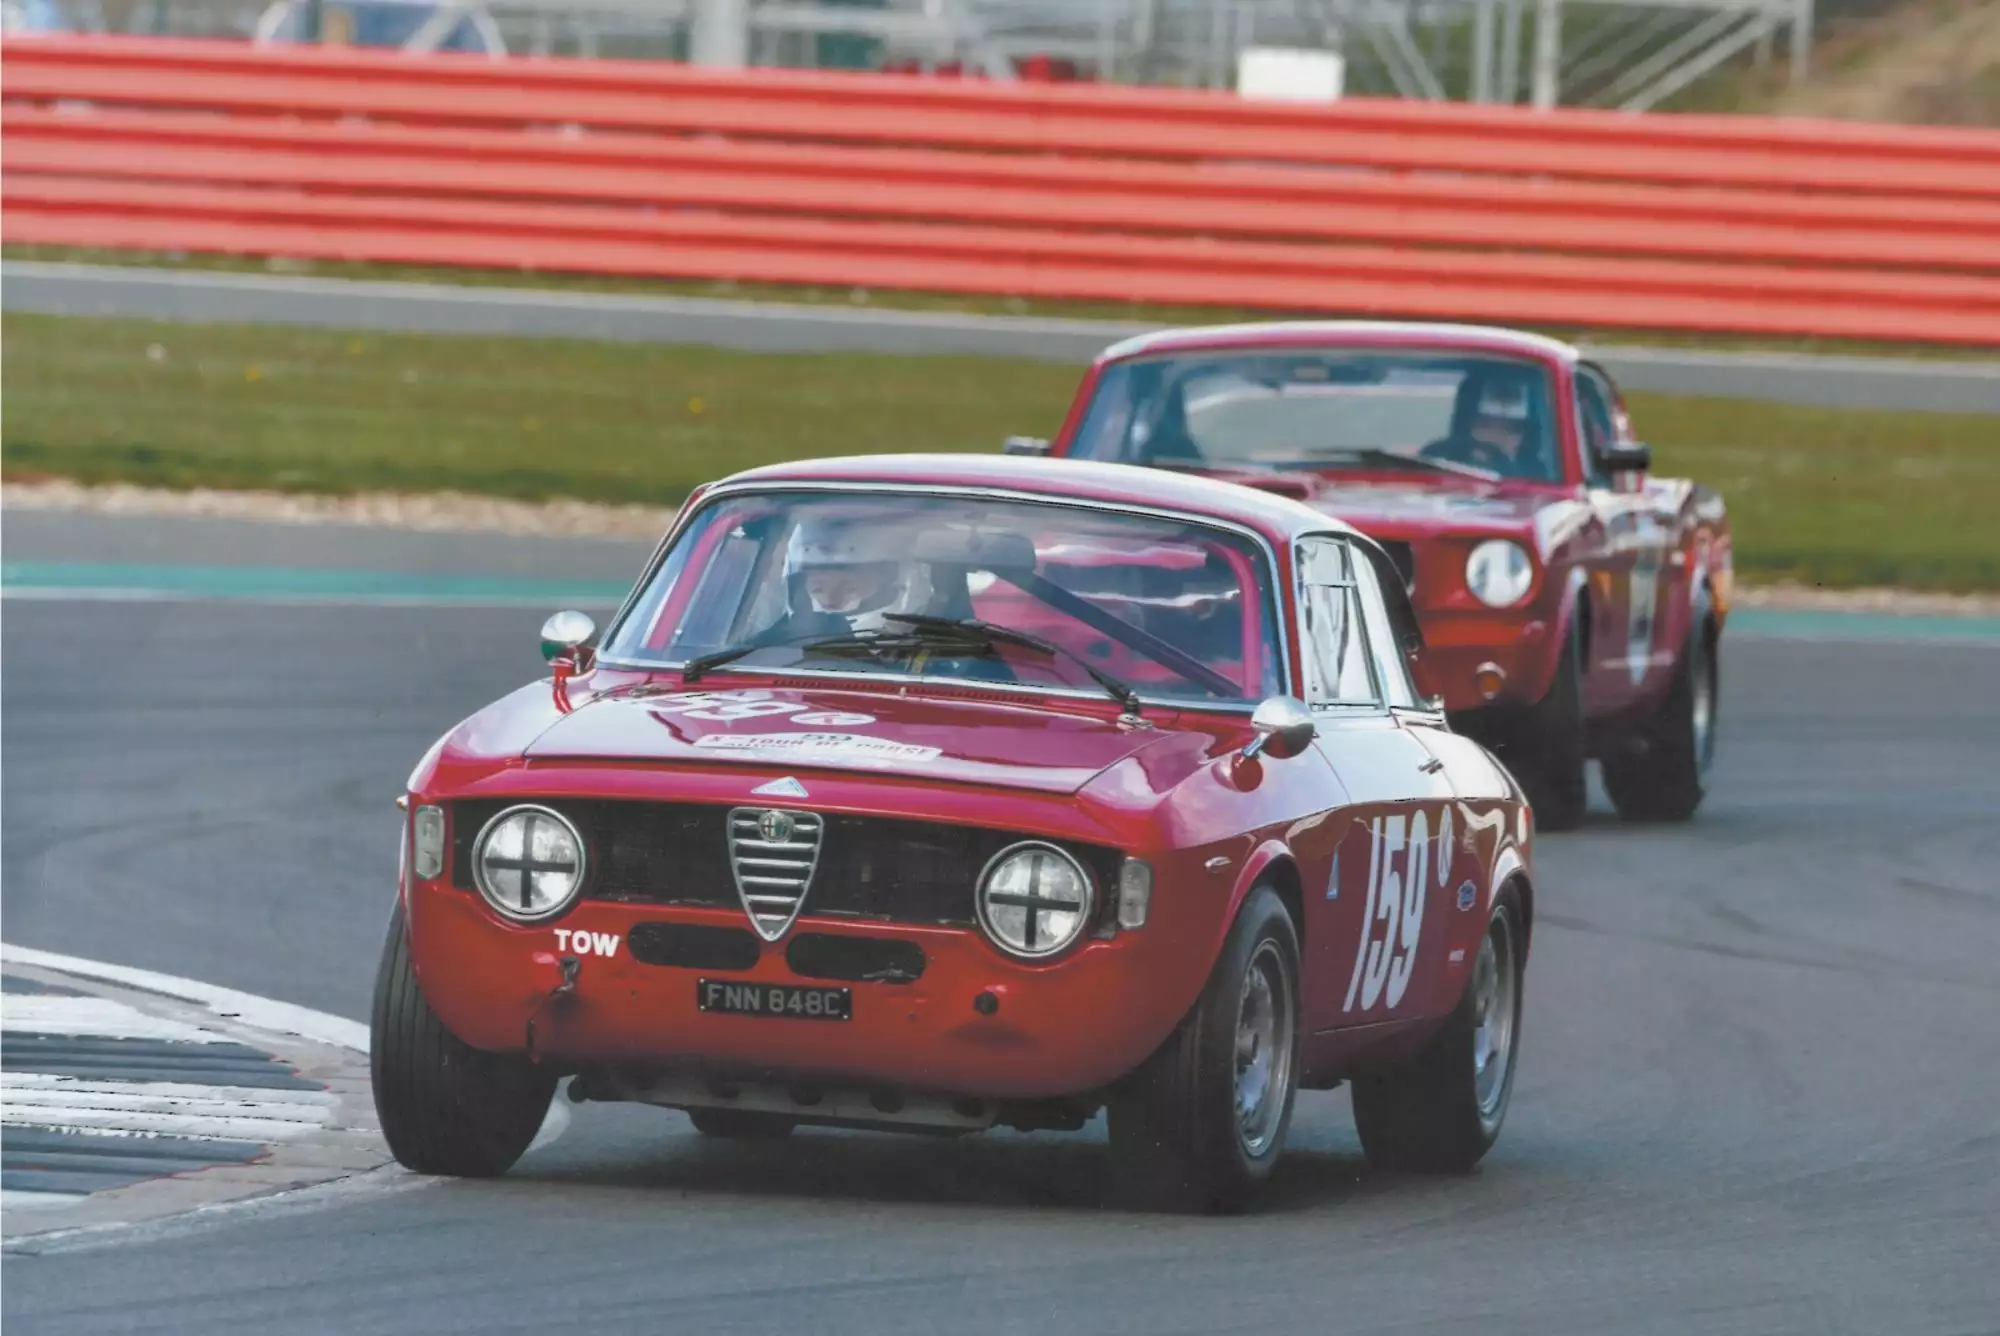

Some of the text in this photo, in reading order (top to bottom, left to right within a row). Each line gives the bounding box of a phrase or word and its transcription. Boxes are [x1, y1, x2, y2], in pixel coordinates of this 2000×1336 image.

[1342, 809, 1429, 1012] 159
[553, 928, 620, 957] TOW
[707, 983, 841, 1015] FNN 848C
